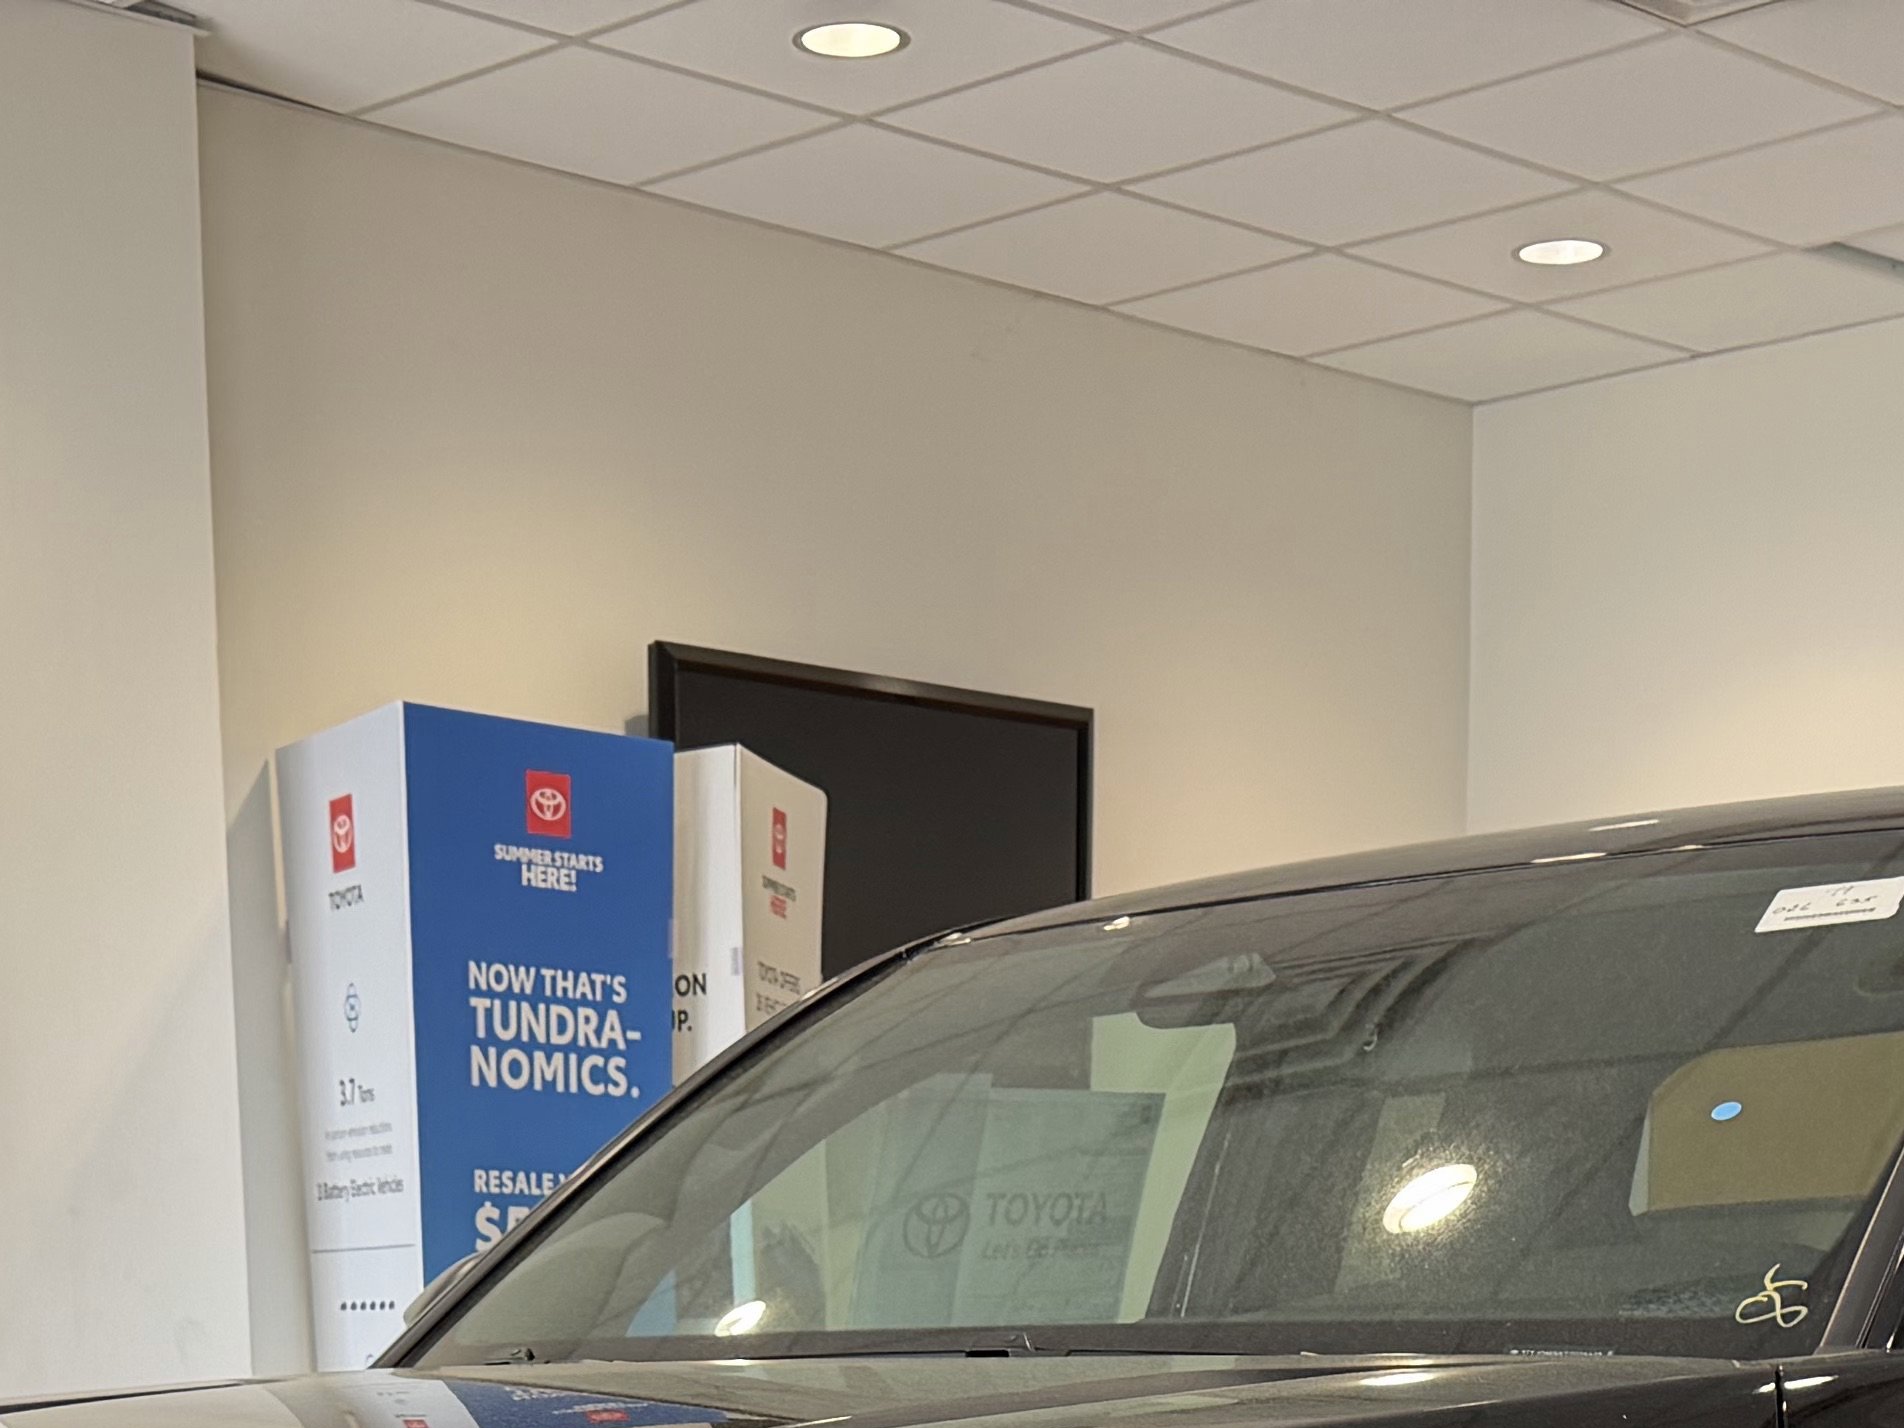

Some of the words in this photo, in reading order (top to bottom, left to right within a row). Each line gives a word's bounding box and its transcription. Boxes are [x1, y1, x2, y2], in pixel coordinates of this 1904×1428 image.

[494, 843, 552, 865] SUMMER
[553, 851, 604, 872] STARTS
[521, 863, 577, 892] HERE!
[468, 960, 536, 995] NOW
[540, 968, 628, 1003] THAT'S
[469, 997, 642, 1050] TUNDRA-
[470, 1045, 641, 1098] NOMICS.
[474, 1169, 554, 1196] RESALE
[985, 1191, 1108, 1227] TOYOTA
